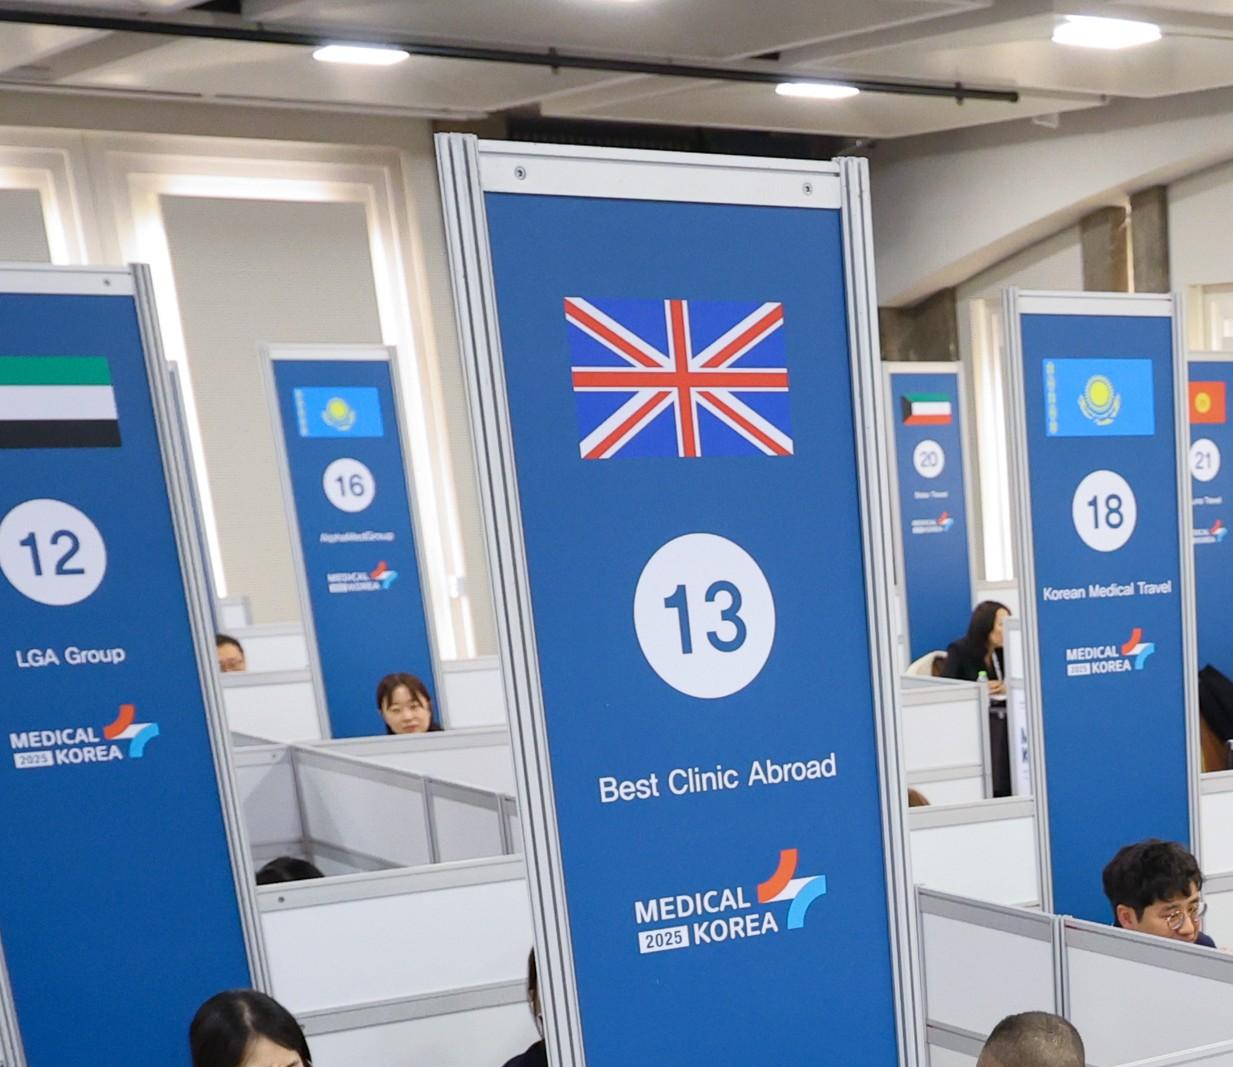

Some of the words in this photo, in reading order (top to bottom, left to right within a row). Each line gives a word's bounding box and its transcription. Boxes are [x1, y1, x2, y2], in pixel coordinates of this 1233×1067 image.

[920, 451, 938, 467] 20
[1195, 452, 1211, 469] 21
[336, 474, 364, 497] 16
[1088, 494, 1123, 529] 18
[19, 530, 85, 577] 12
[1043, 587, 1086, 600] Korean
[1088, 582, 1134, 598] Medical
[1137, 580, 1172, 595] Travel
[664, 580, 747, 654] 13
[16, 649, 58, 669] LGA
[64, 646, 126, 668] Group
[1066, 645, 1119, 660] MEDICAL
[1091, 659, 1131, 674] KOREA
[9, 727, 100, 749] MEDICAL
[20, 753, 48, 765] 2025
[55, 745, 123, 764] KOREA
[599, 773, 660, 803] Best
[668, 765, 739, 796] Clinic
[748, 753, 837, 786] Abroad
[635, 886, 751, 923] MEDICAL
[645, 930, 683, 950] 2025
[694, 911, 779, 945] KOREA
